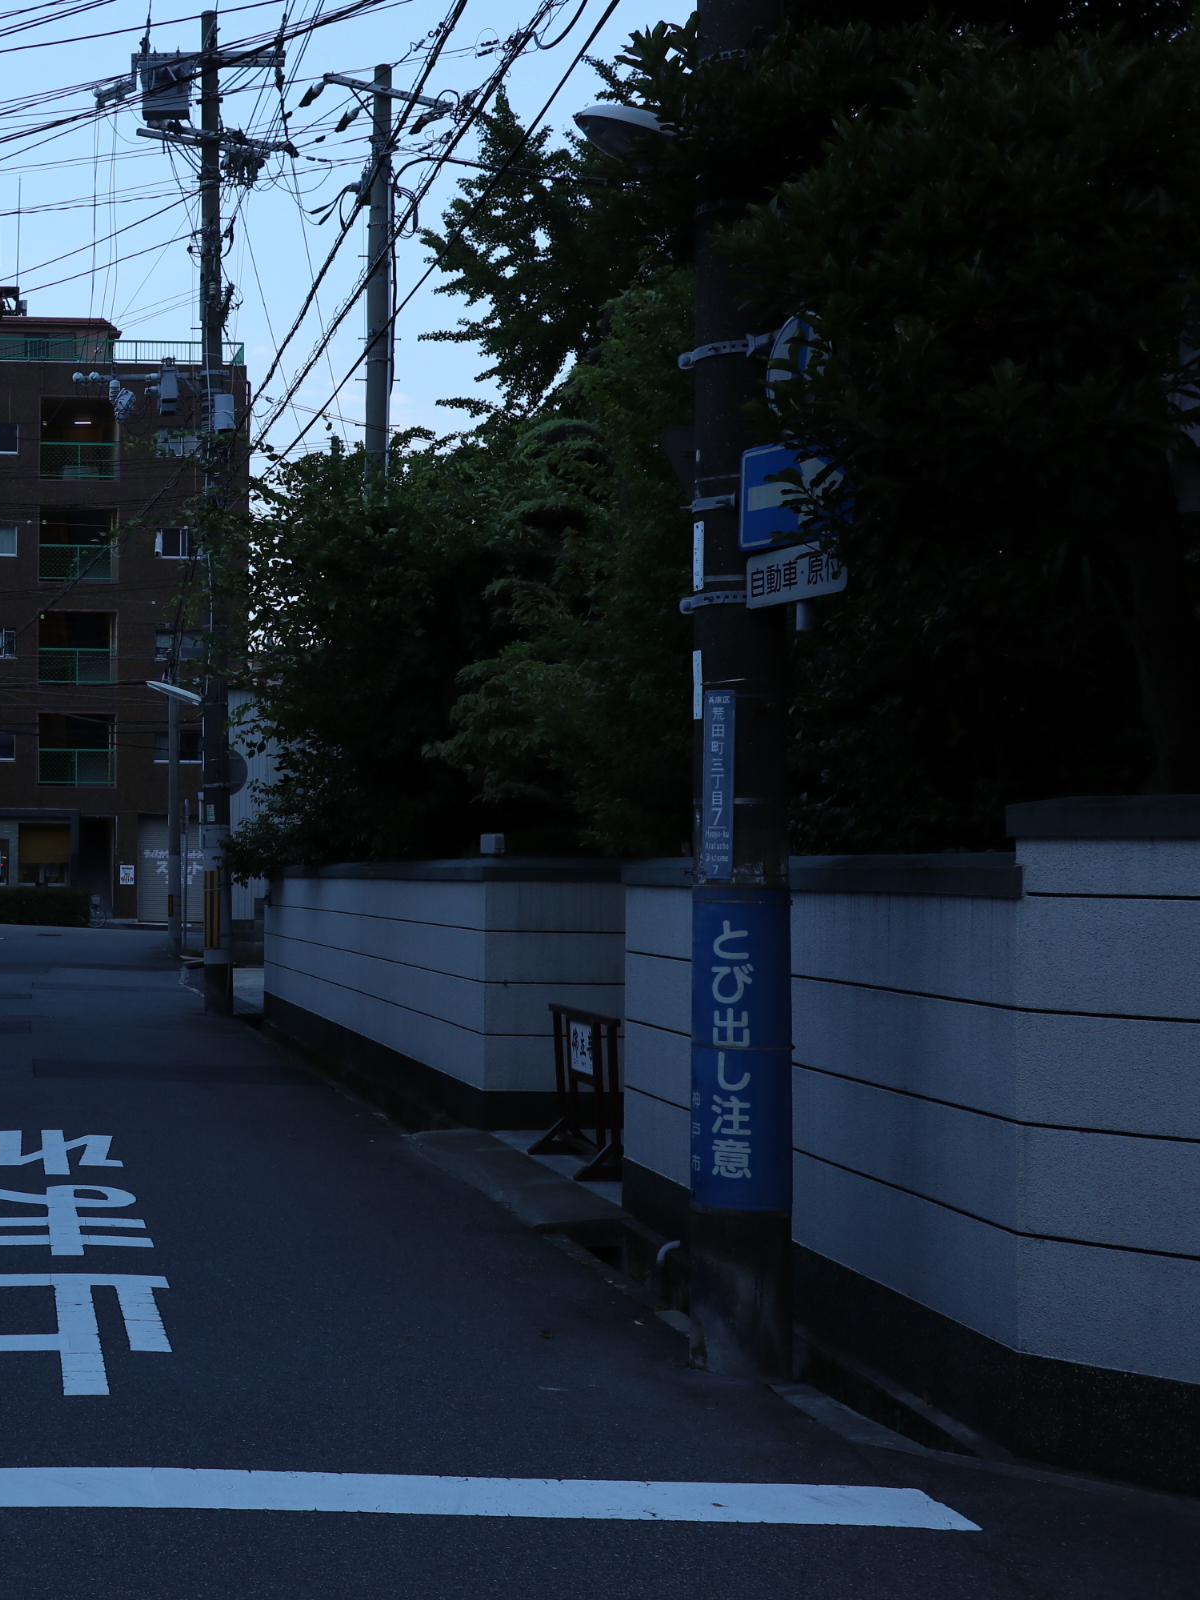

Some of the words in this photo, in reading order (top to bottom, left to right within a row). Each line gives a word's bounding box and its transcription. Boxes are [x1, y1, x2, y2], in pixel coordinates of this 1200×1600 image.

[708, 695, 730, 704] 兵庫区
[705, 830, 730, 839] Hyogo-ku
[712, 865, 719, 874] 7
[711, 919, 754, 1179] とび出し注意
